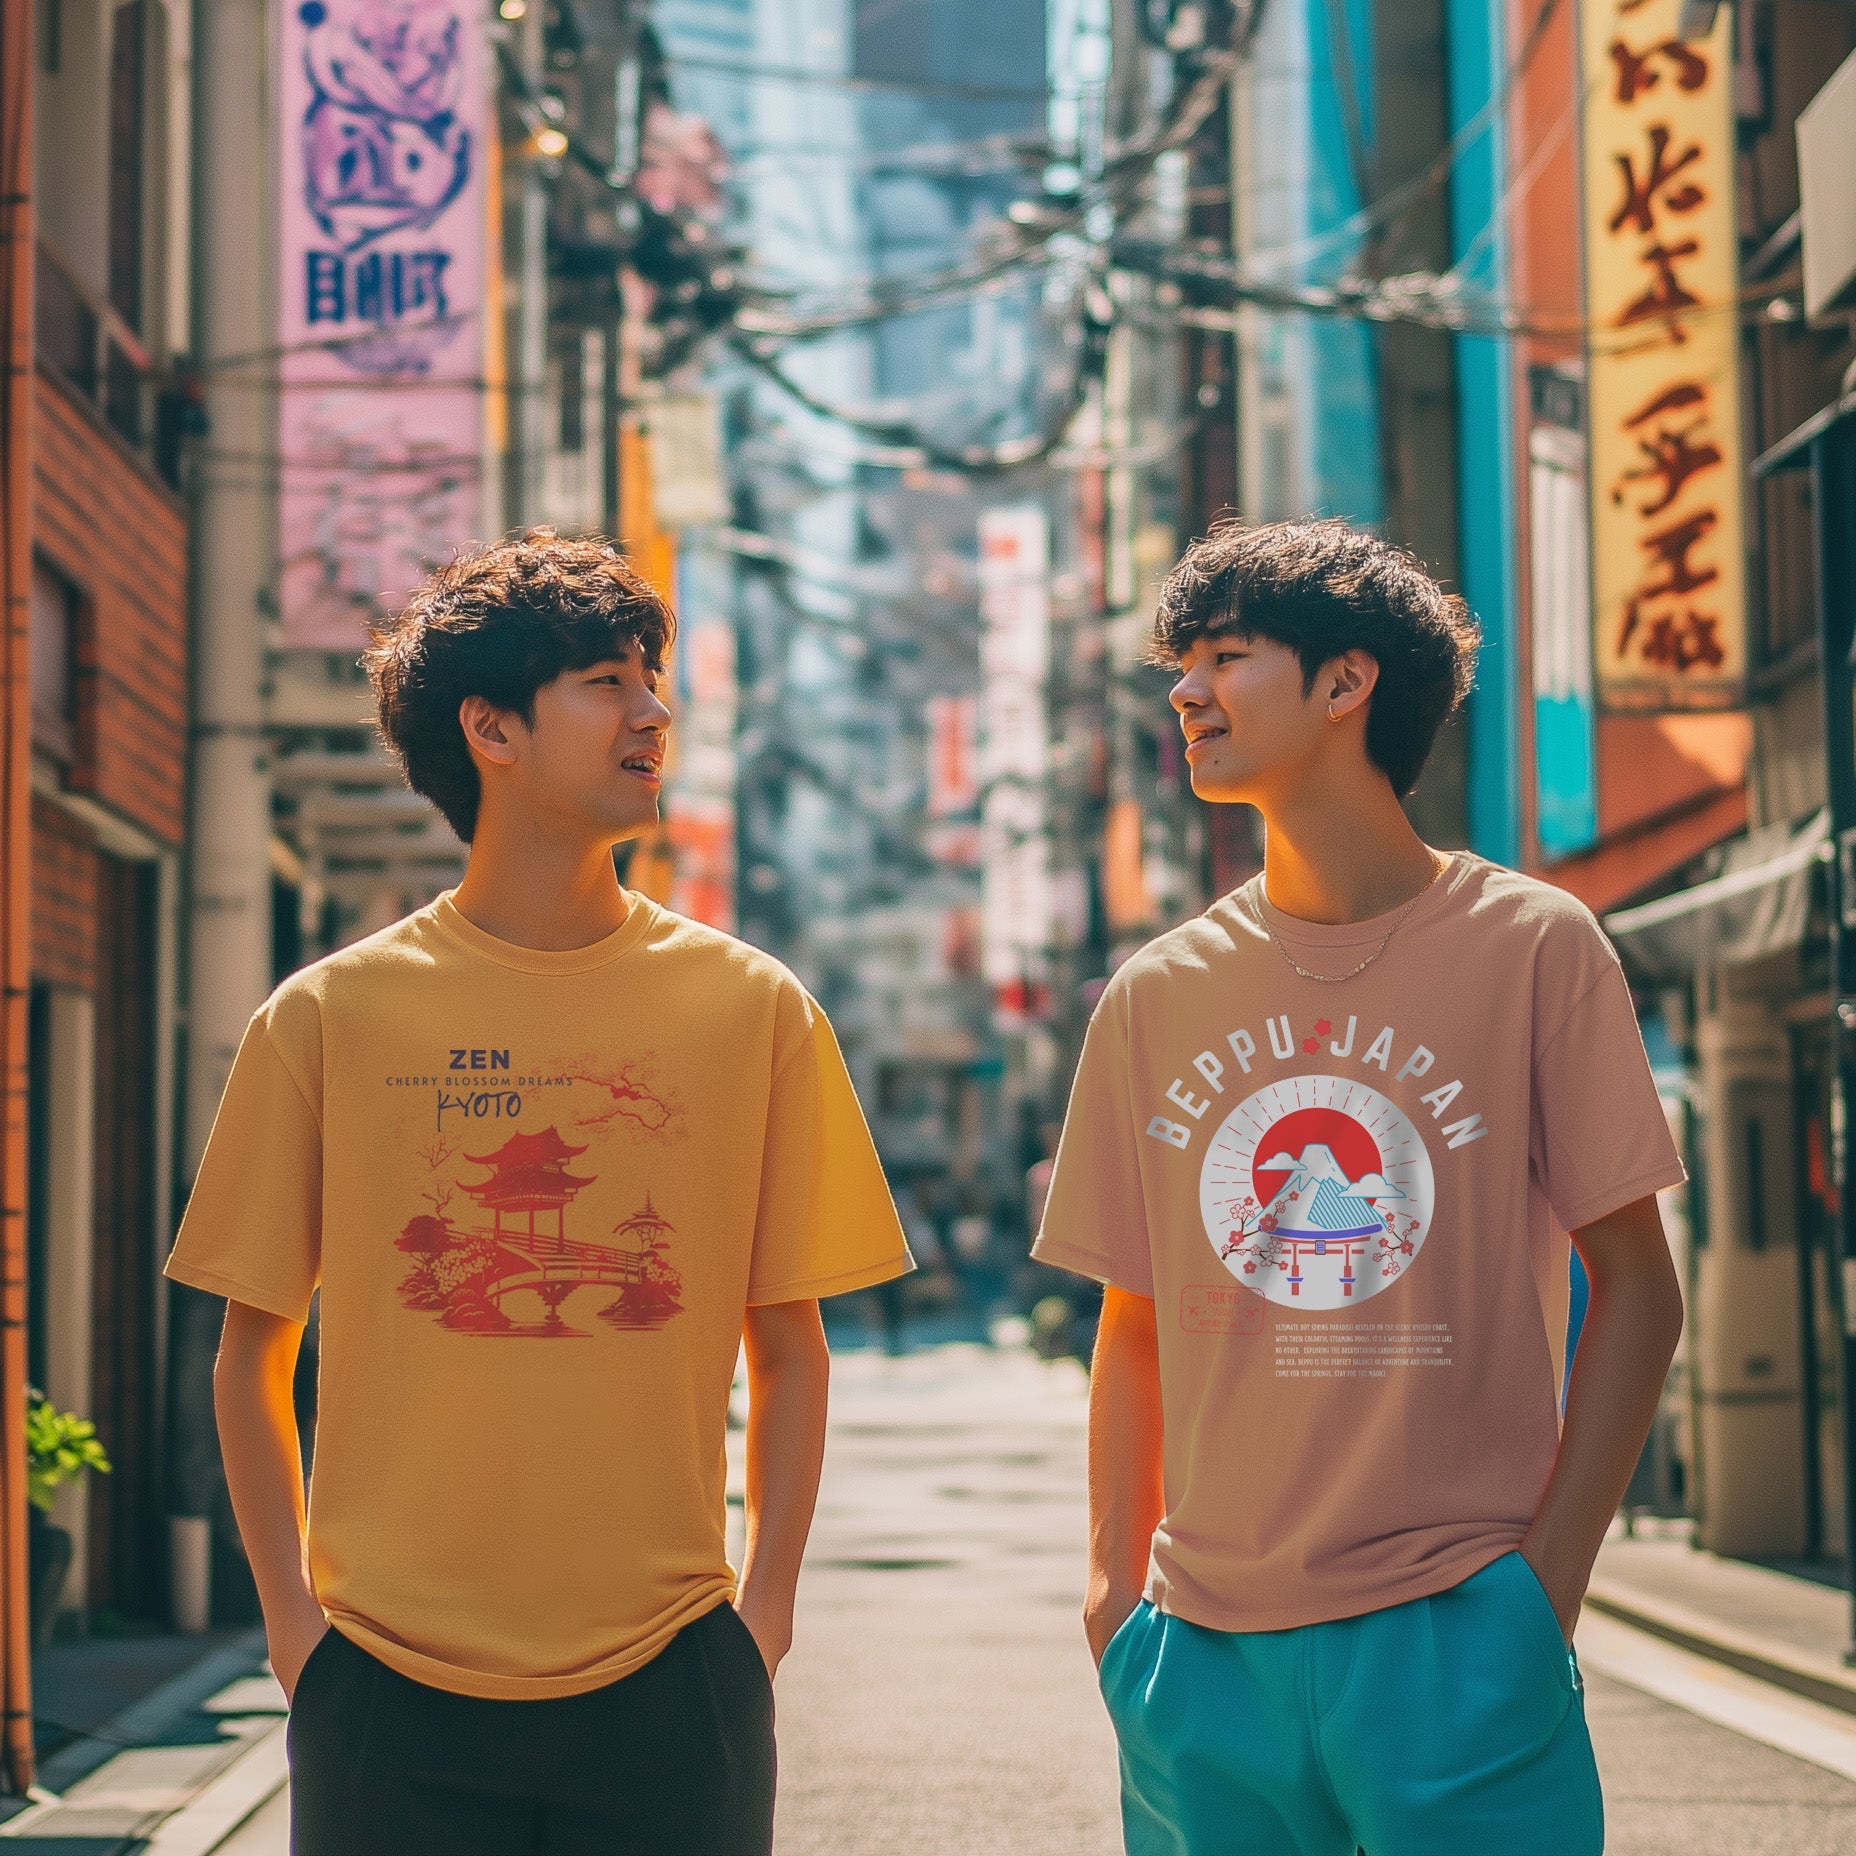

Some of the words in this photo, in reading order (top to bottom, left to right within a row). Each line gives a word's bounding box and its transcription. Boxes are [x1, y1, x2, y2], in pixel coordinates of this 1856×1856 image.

[449, 1049, 510, 1070] ZEN
[385, 1076, 438, 1086] CHERRY
[445, 1076, 511, 1086] BLOSSOM
[518, 1076, 573, 1086] DREAMS
[1145, 1014, 1295, 1150] BEPPU
[1329, 1015, 1489, 1150] JAPAN
[437, 1089, 522, 1132] KYOTO
[1275, 1323, 1299, 1331] ULTIMATE
[1311, 1323, 1328, 1331] SPRING
[1275, 1335, 1288, 1343] WITH
[1289, 1335, 1303, 1343] THEIR
[1305, 1335, 1328, 1343] COLORFUL
[1330, 1335, 1353, 1343] STEAMING
[1388, 1335, 1412, 1343] WELLNESS
[1413, 1335, 1440, 1343] EXPERIENCE
[1442, 1335, 1453, 1343] LIKE
[1275, 1358, 1285, 1366] AND
[1298, 1358, 1313, 1366] BEPPU
[1315, 1358, 1319, 1366] IS
[1321, 1358, 1329, 1366] THE
[1331, 1358, 1351, 1366] PERFECT
[1375, 1358, 1381, 1366] OF
[1382, 1358, 1408, 1366] ADVENTURE
[1410, 1358, 1420, 1366] AND
